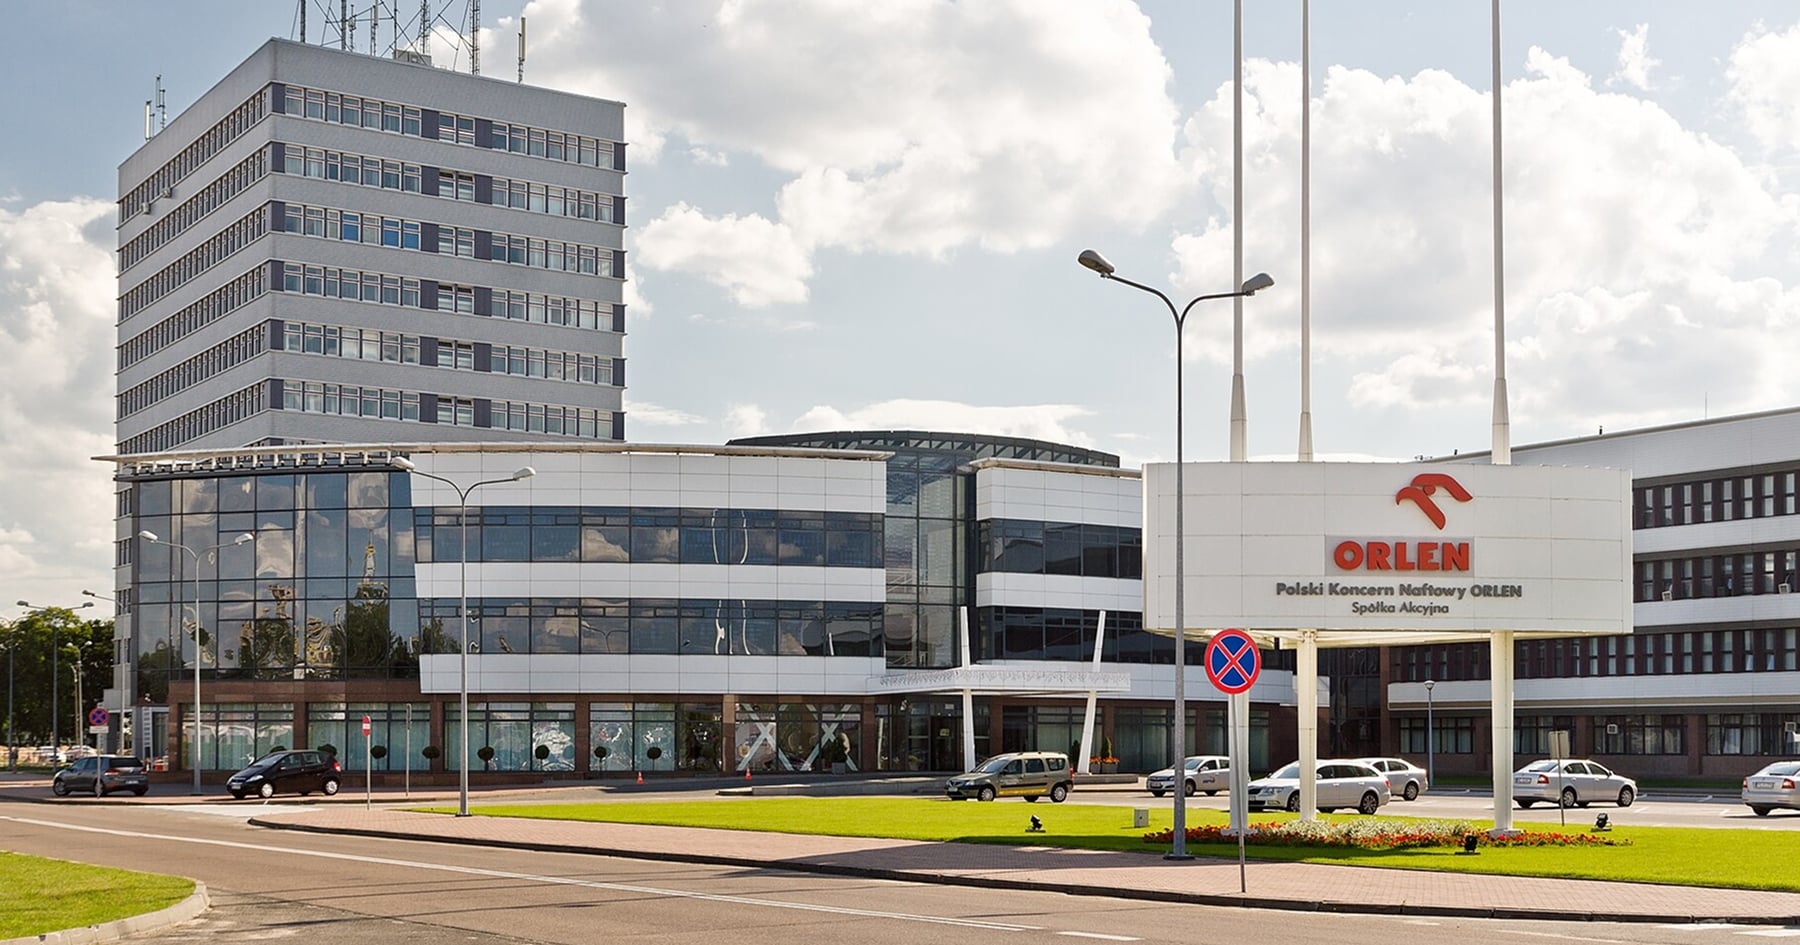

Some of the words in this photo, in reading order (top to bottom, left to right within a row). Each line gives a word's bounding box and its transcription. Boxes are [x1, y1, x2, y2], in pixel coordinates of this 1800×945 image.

[1333, 540, 1470, 572] ORLEN
[1276, 582, 1324, 596] Polski
[1328, 582, 1395, 596] Koncern
[1399, 583, 1467, 600] Naftowy
[1470, 584, 1523, 598] ORLEN
[1351, 601, 1396, 616] Spółka
[1399, 601, 1450, 616] Akcyjna
